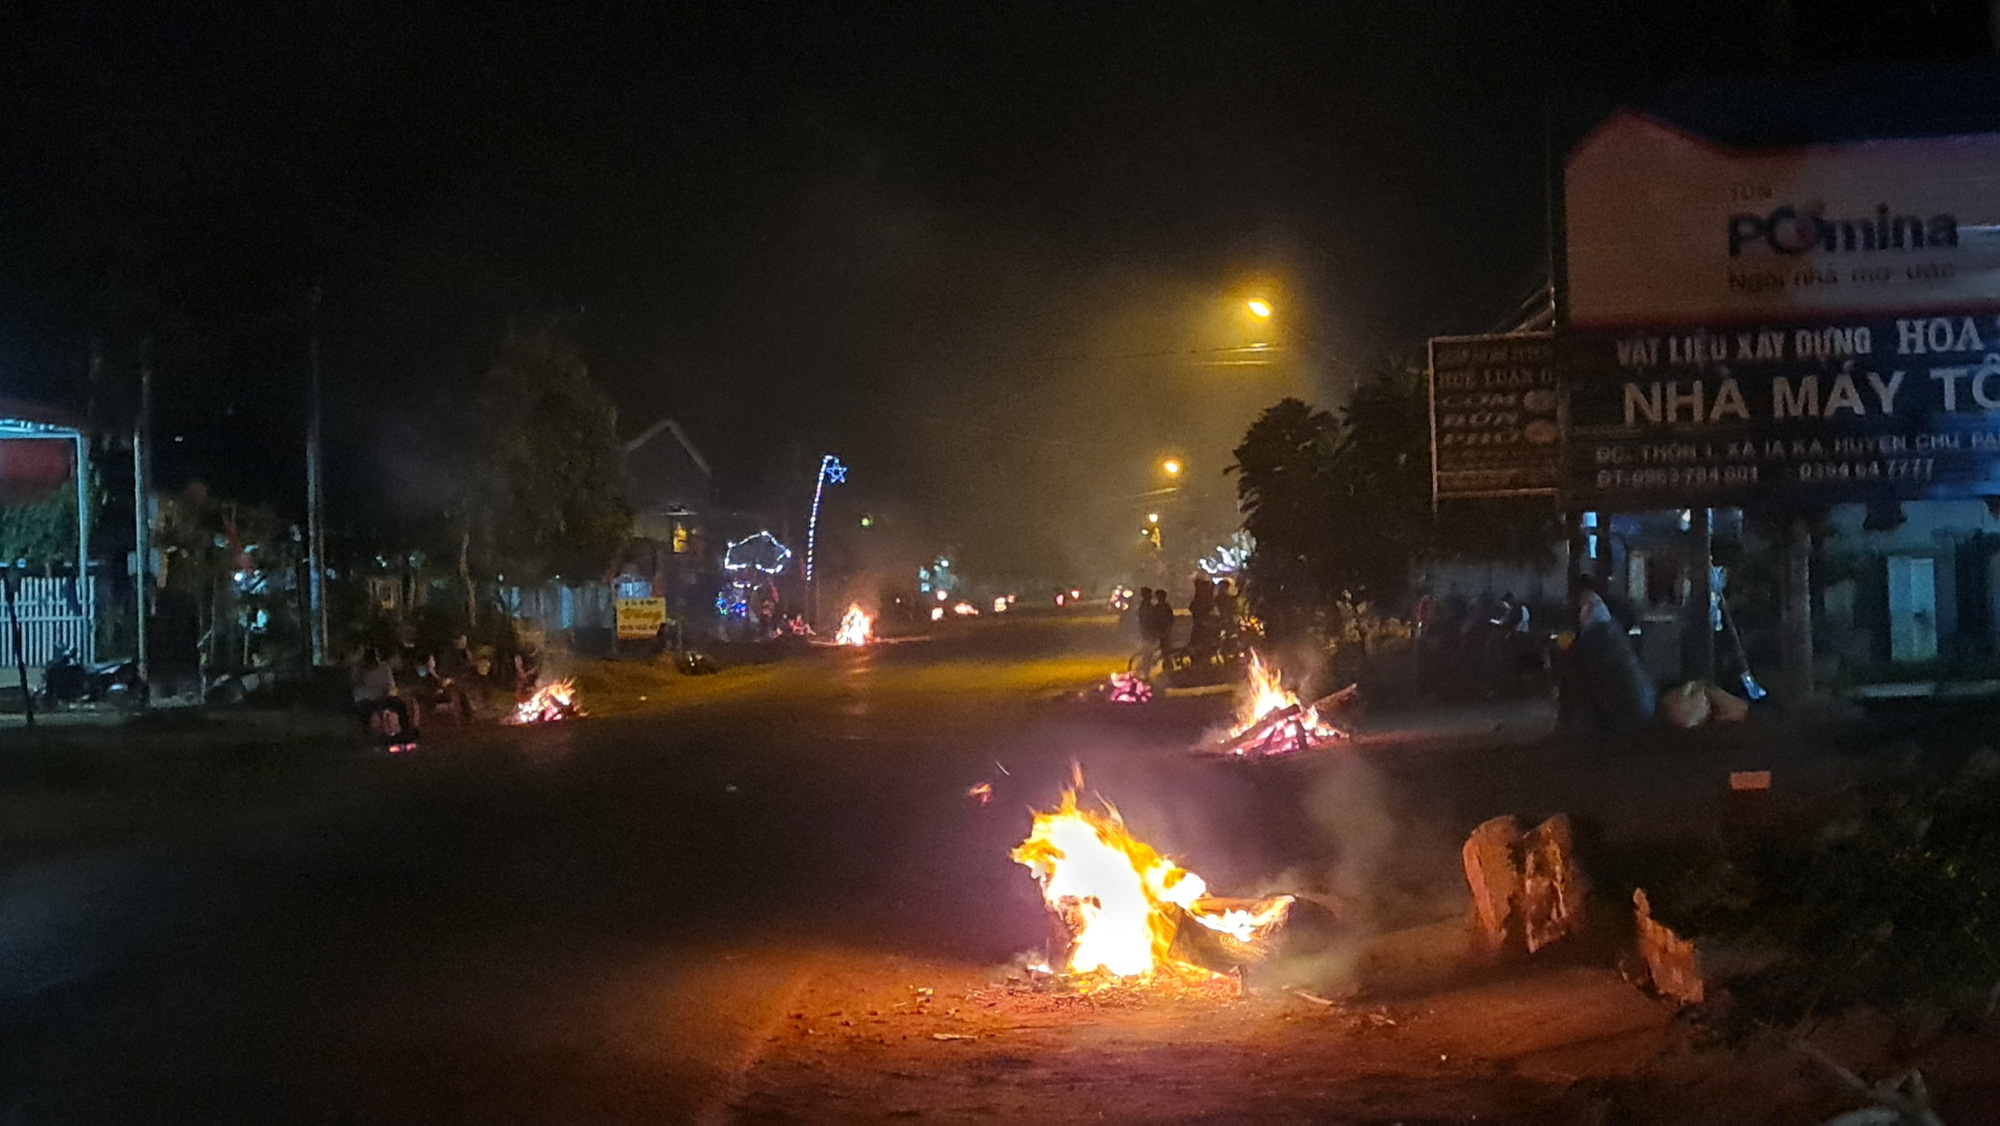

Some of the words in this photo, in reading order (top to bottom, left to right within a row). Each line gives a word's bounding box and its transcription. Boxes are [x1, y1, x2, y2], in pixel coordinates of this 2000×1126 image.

[1896, 316, 1985, 354] HOA
[1625, 365, 1750, 426] NHÀ
[1772, 360, 1906, 418] MÁY
